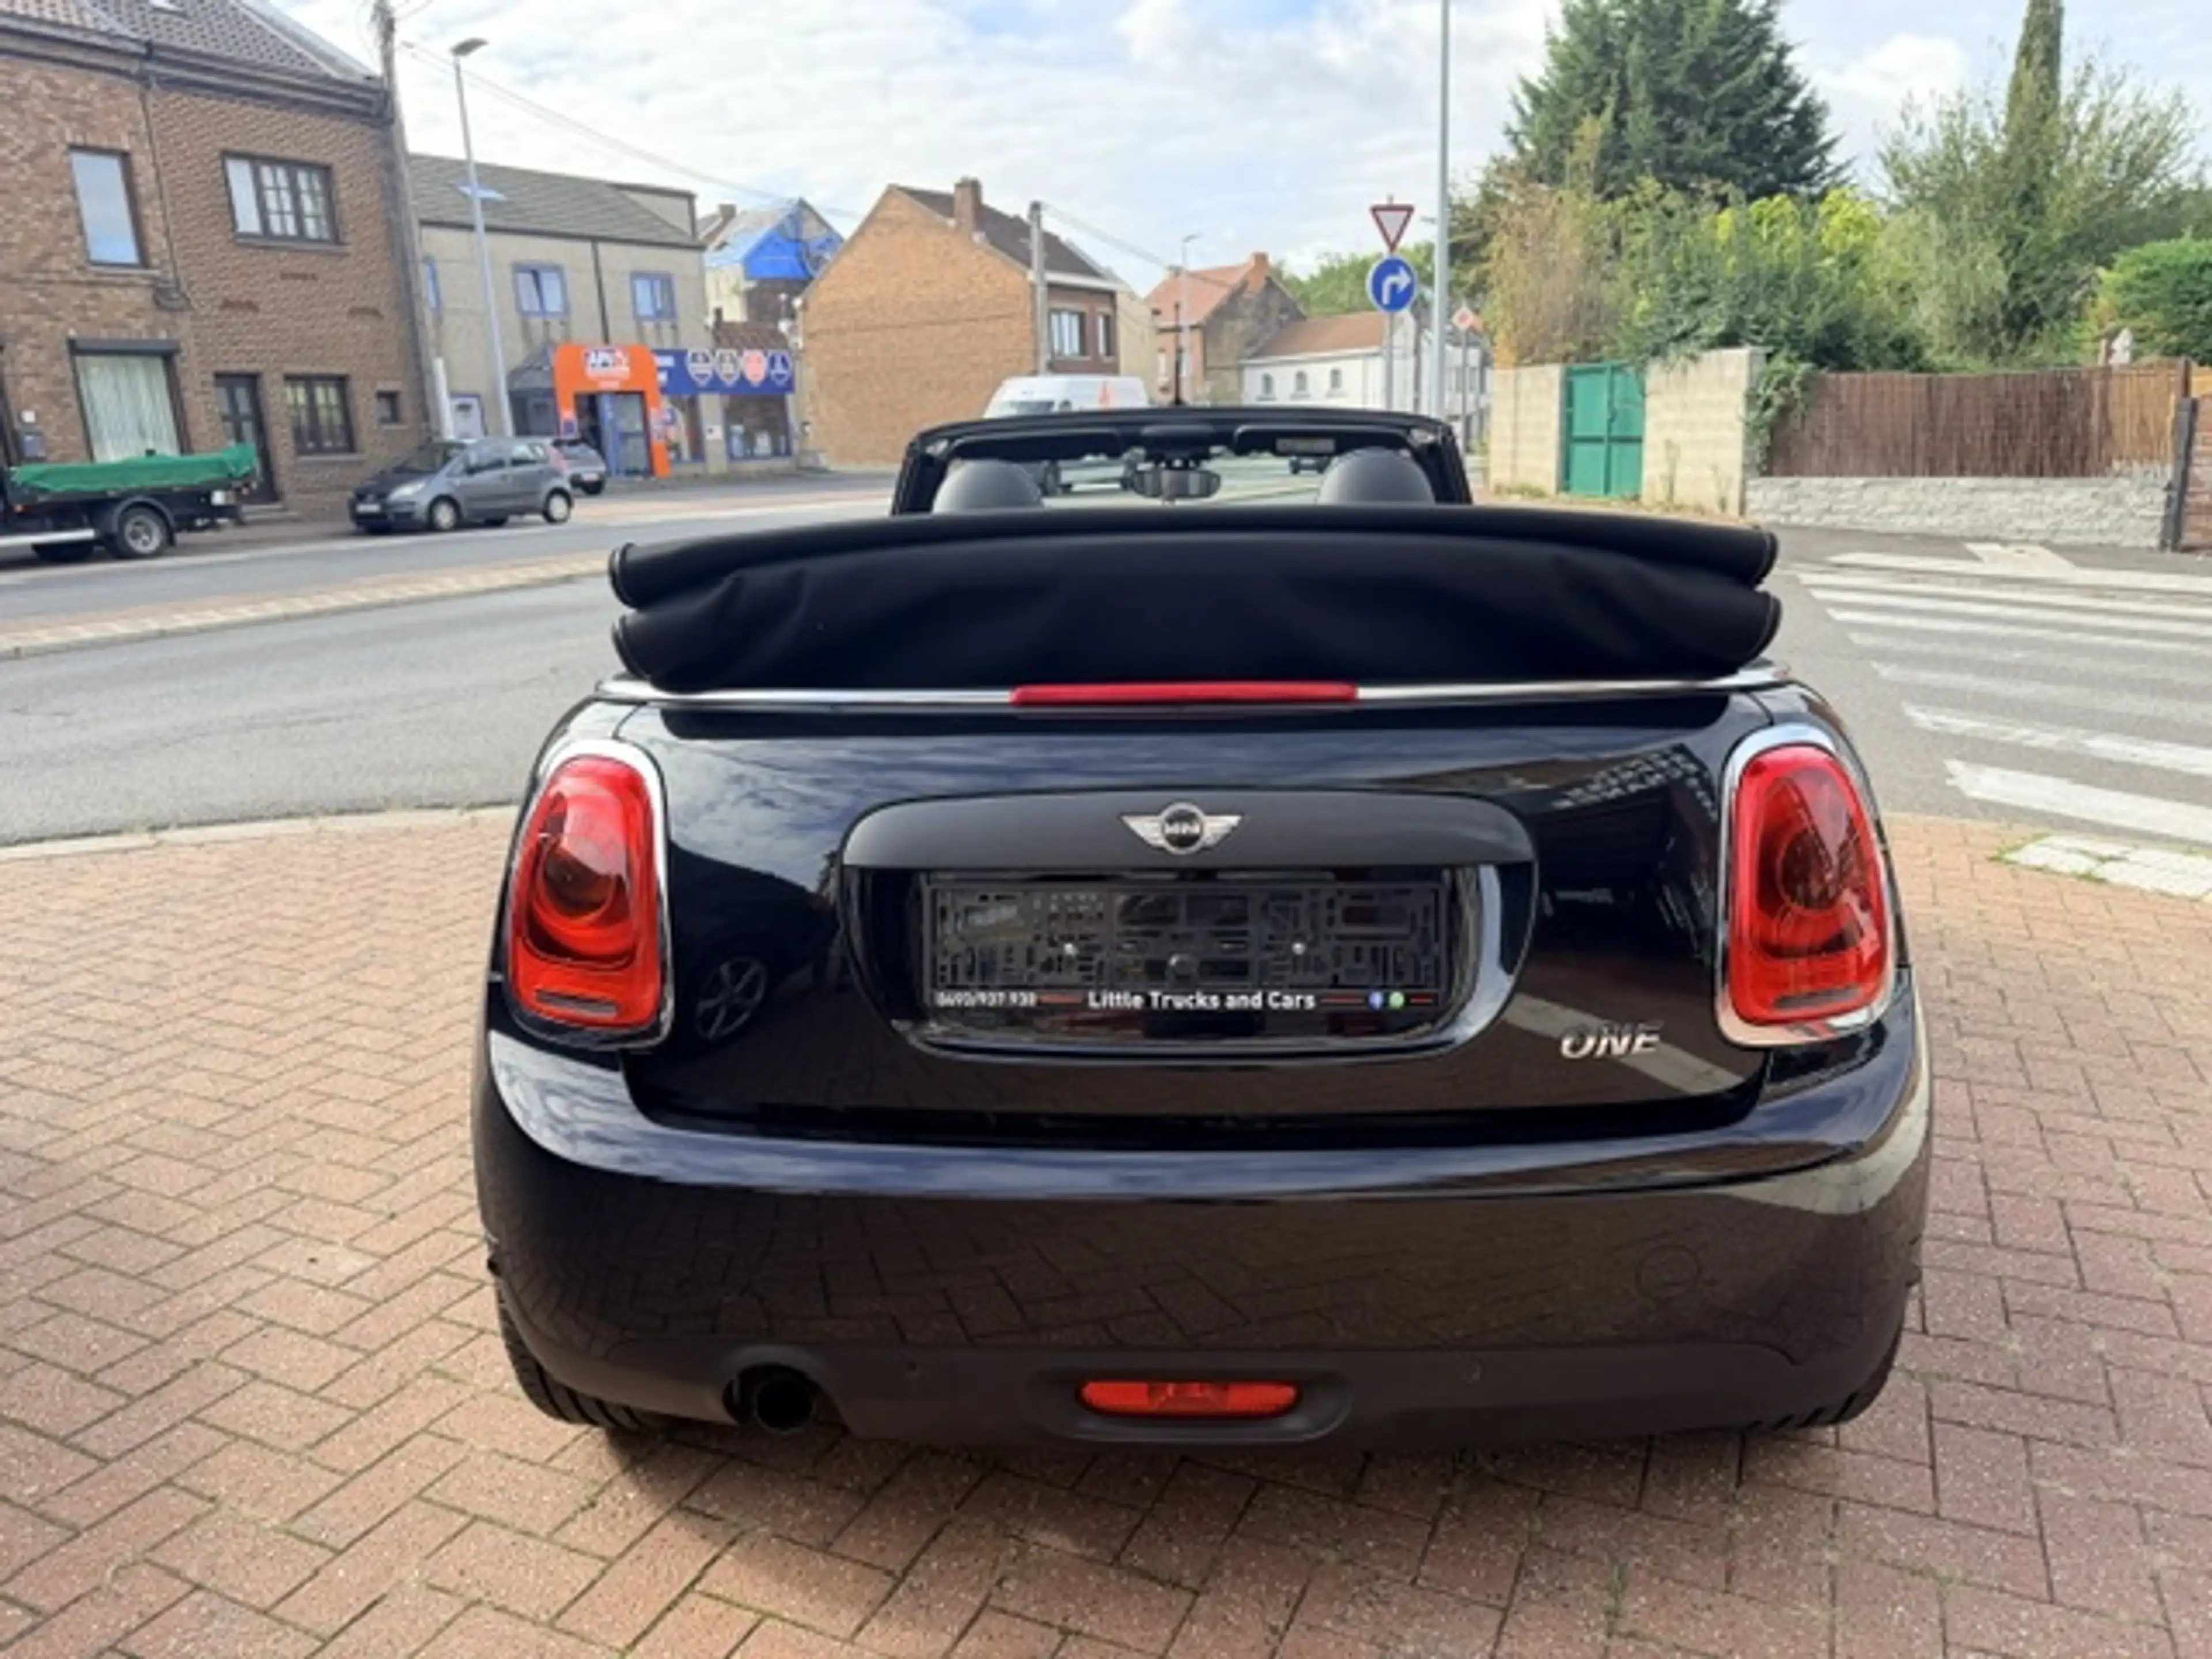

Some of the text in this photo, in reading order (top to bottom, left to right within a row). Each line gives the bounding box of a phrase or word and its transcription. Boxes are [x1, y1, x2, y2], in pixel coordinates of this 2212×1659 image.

[1088, 990, 1316, 1010] Little Trucks and Cars
[1560, 1020, 1663, 1059] ONE
